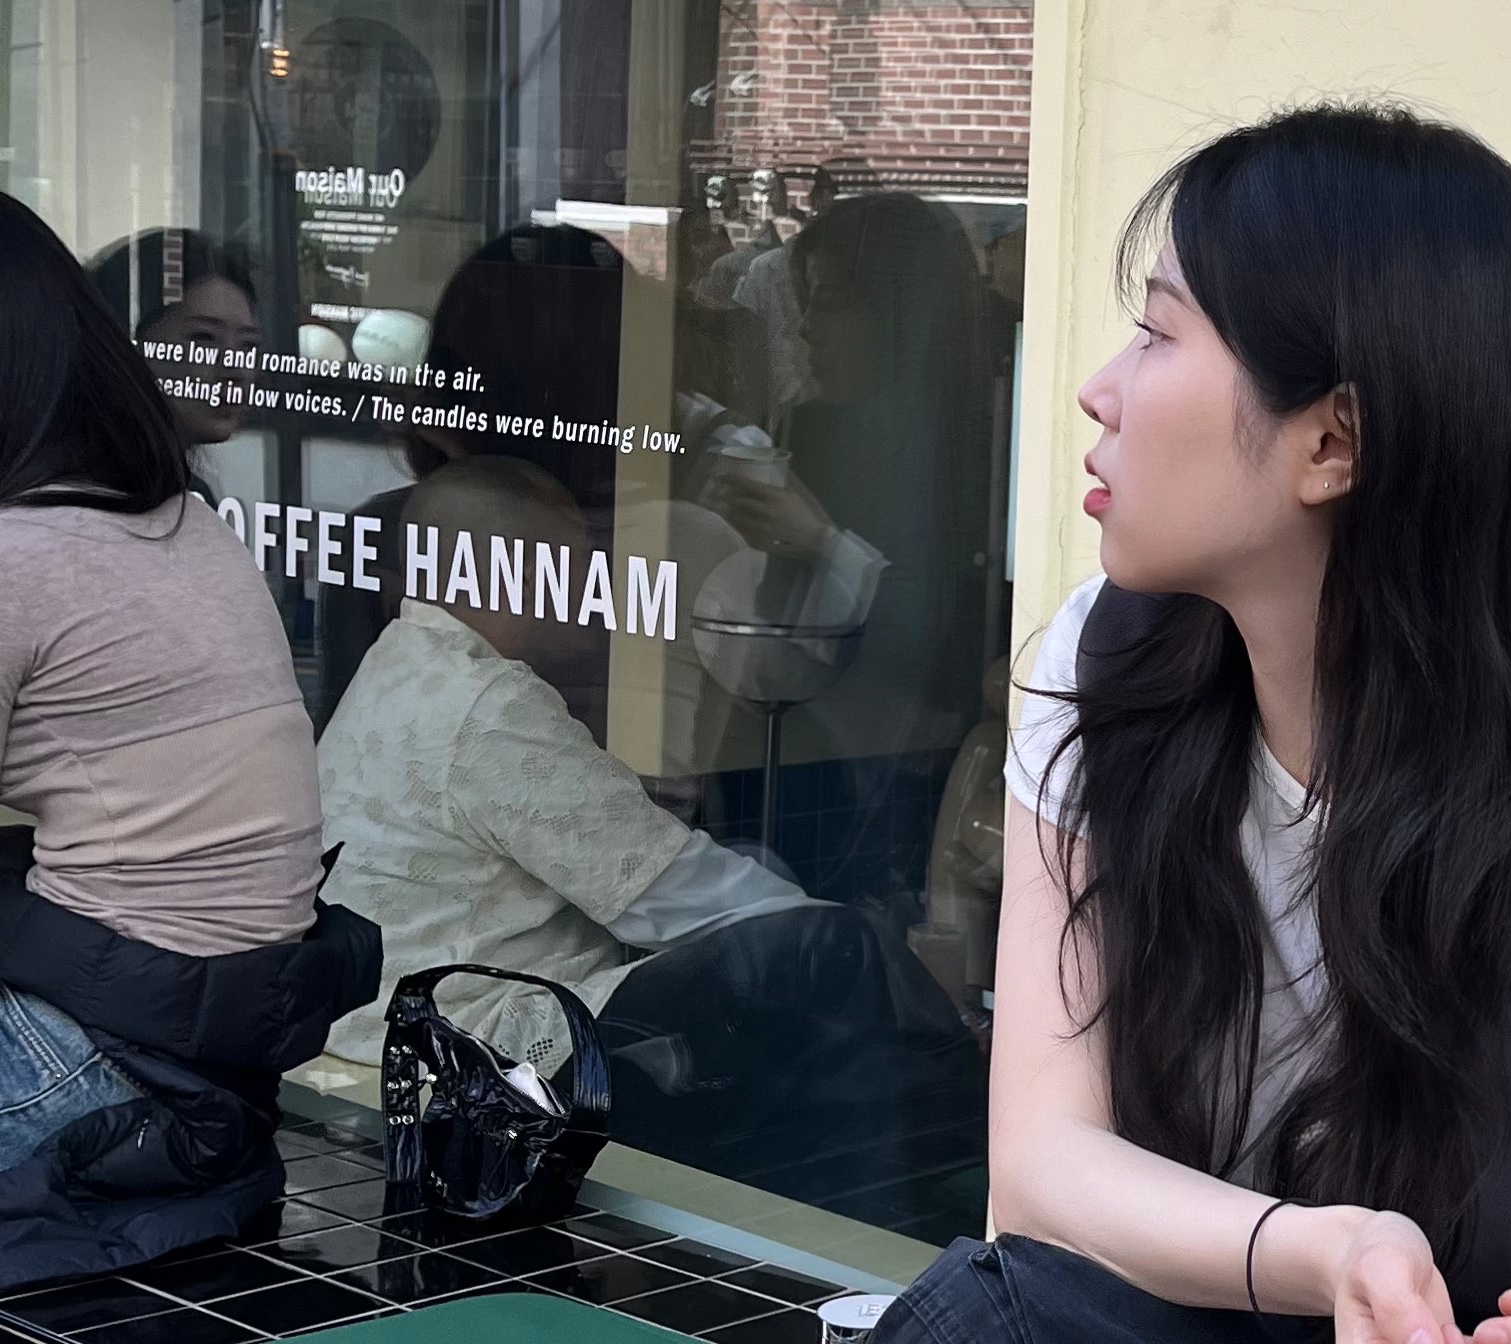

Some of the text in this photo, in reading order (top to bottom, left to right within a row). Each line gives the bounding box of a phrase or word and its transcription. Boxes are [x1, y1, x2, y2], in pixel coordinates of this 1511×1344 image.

[143, 340, 485, 392] were low and romance was in the air.
[226, 381, 243, 405] in
[249, 383, 279, 408] low
[285, 390, 347, 416] voices.
[371, 395, 405, 422] The
[411, 405, 488, 432] candles
[496, 414, 544, 438] were
[552, 415, 635, 454] burning
[642, 424, 686, 454] low.
[405, 523, 679, 641] HANNAM
